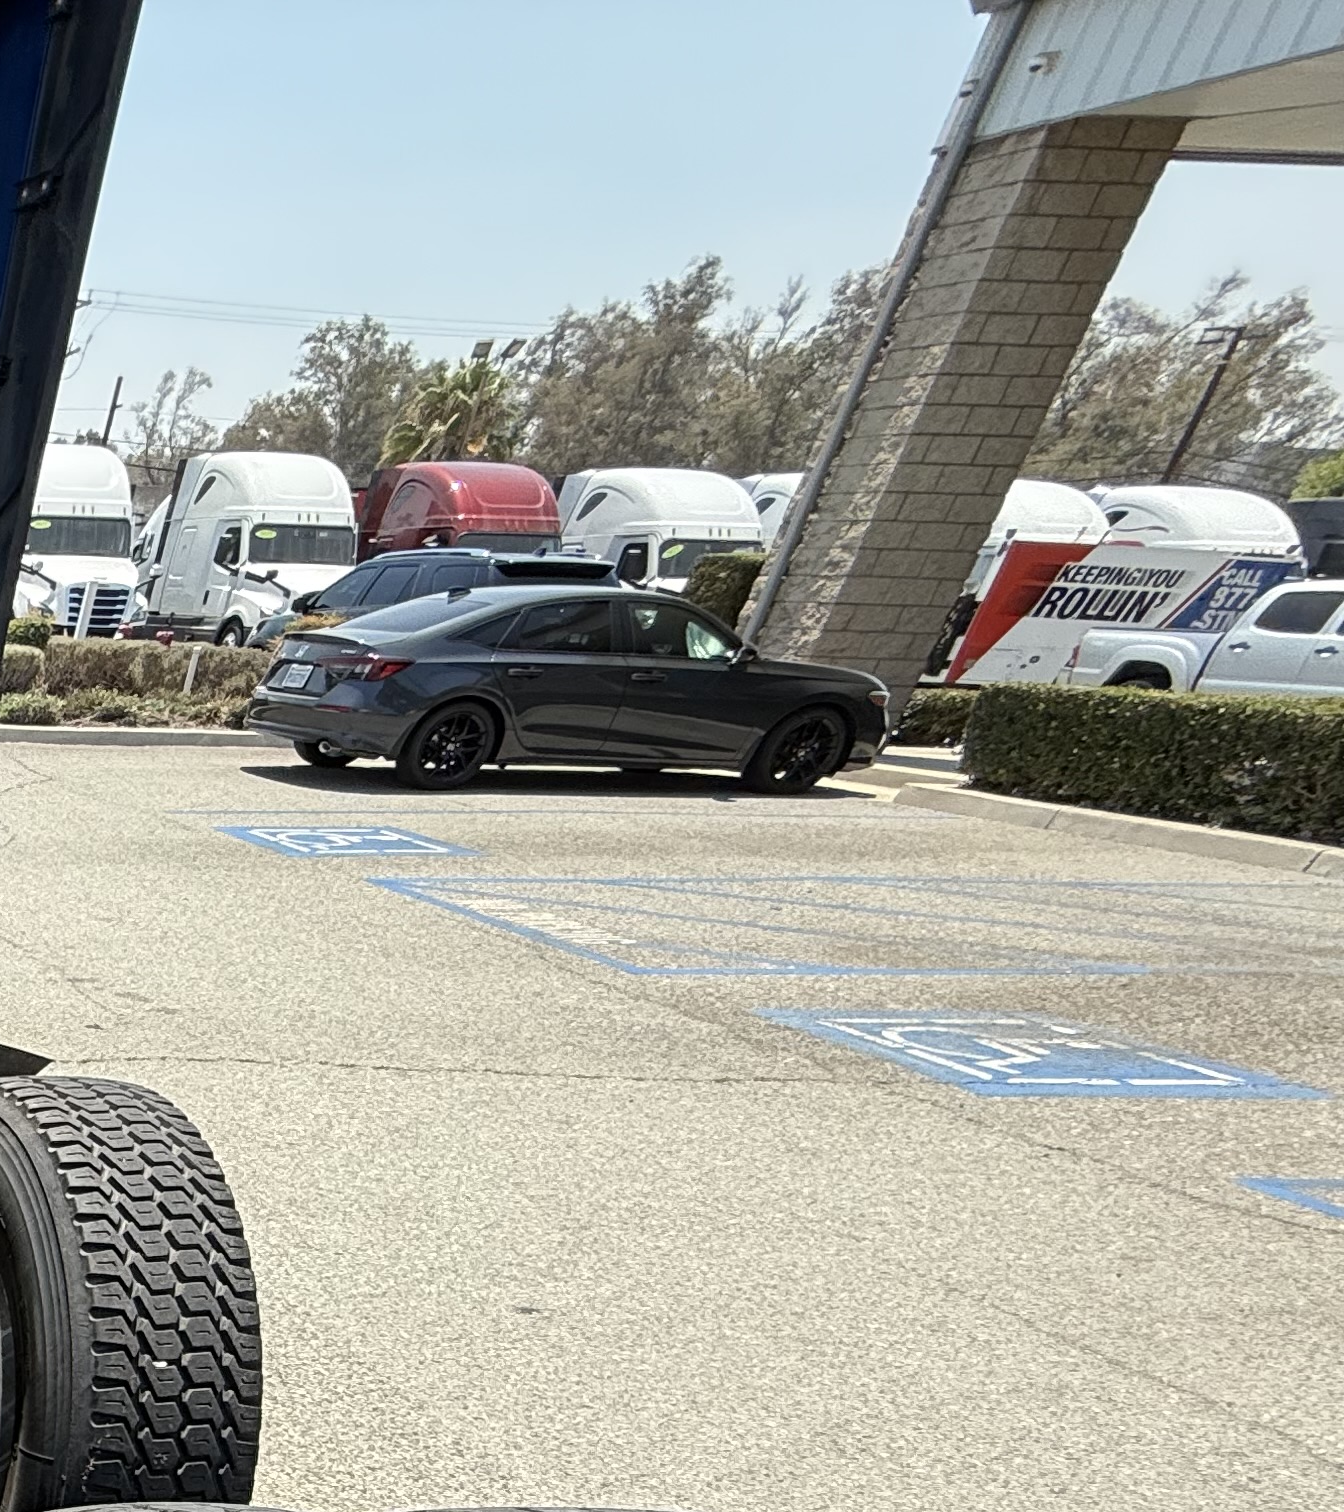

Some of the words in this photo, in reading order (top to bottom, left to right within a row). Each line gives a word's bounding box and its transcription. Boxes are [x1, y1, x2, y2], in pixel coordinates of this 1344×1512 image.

[1057, 564, 1143, 587] KEEPING
[1143, 569, 1185, 588] YOU
[1221, 568, 1263, 587] CALL
